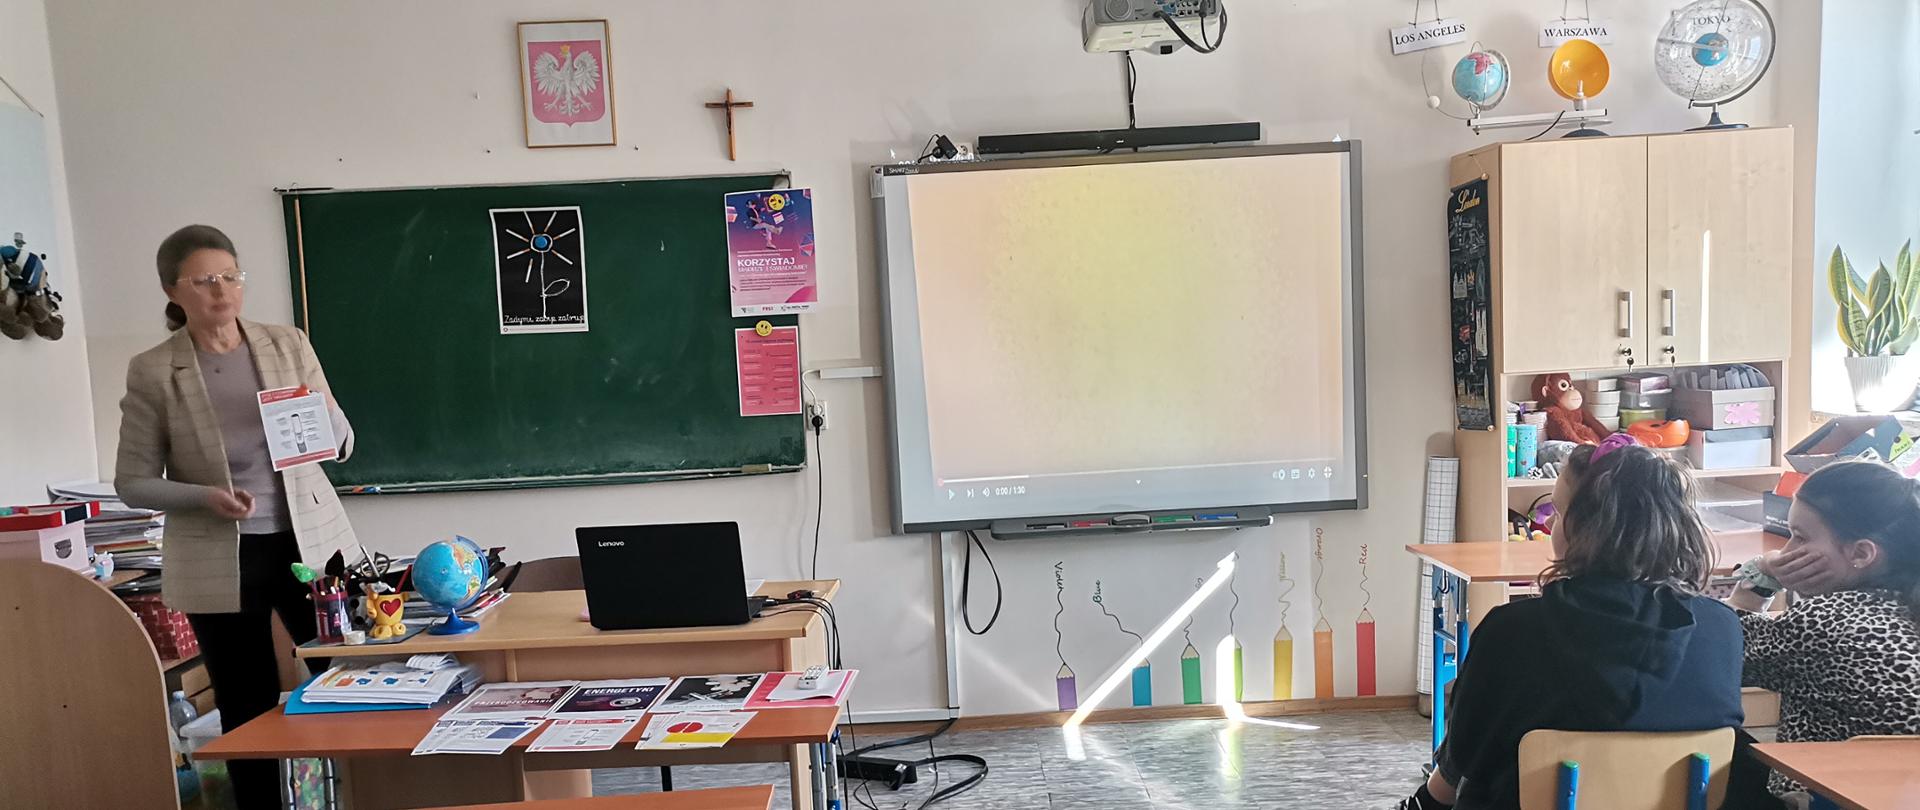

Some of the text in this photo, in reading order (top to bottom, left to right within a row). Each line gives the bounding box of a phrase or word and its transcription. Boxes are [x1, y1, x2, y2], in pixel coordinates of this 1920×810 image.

[1692, 15, 1731, 26] TOKYO
[1395, 23, 1466, 45] LOS ANGELES
[1544, 27, 1608, 37] WARSZAWA
[737, 257, 795, 267] KORZYSTAJ
[995, 487, 1008, 496] 0:00
[1359, 543, 1368, 565] Red
[1054, 561, 1064, 590] Violet
[1092, 579, 1102, 603] Blue
[583, 686, 655, 695] ENERGETYKI
